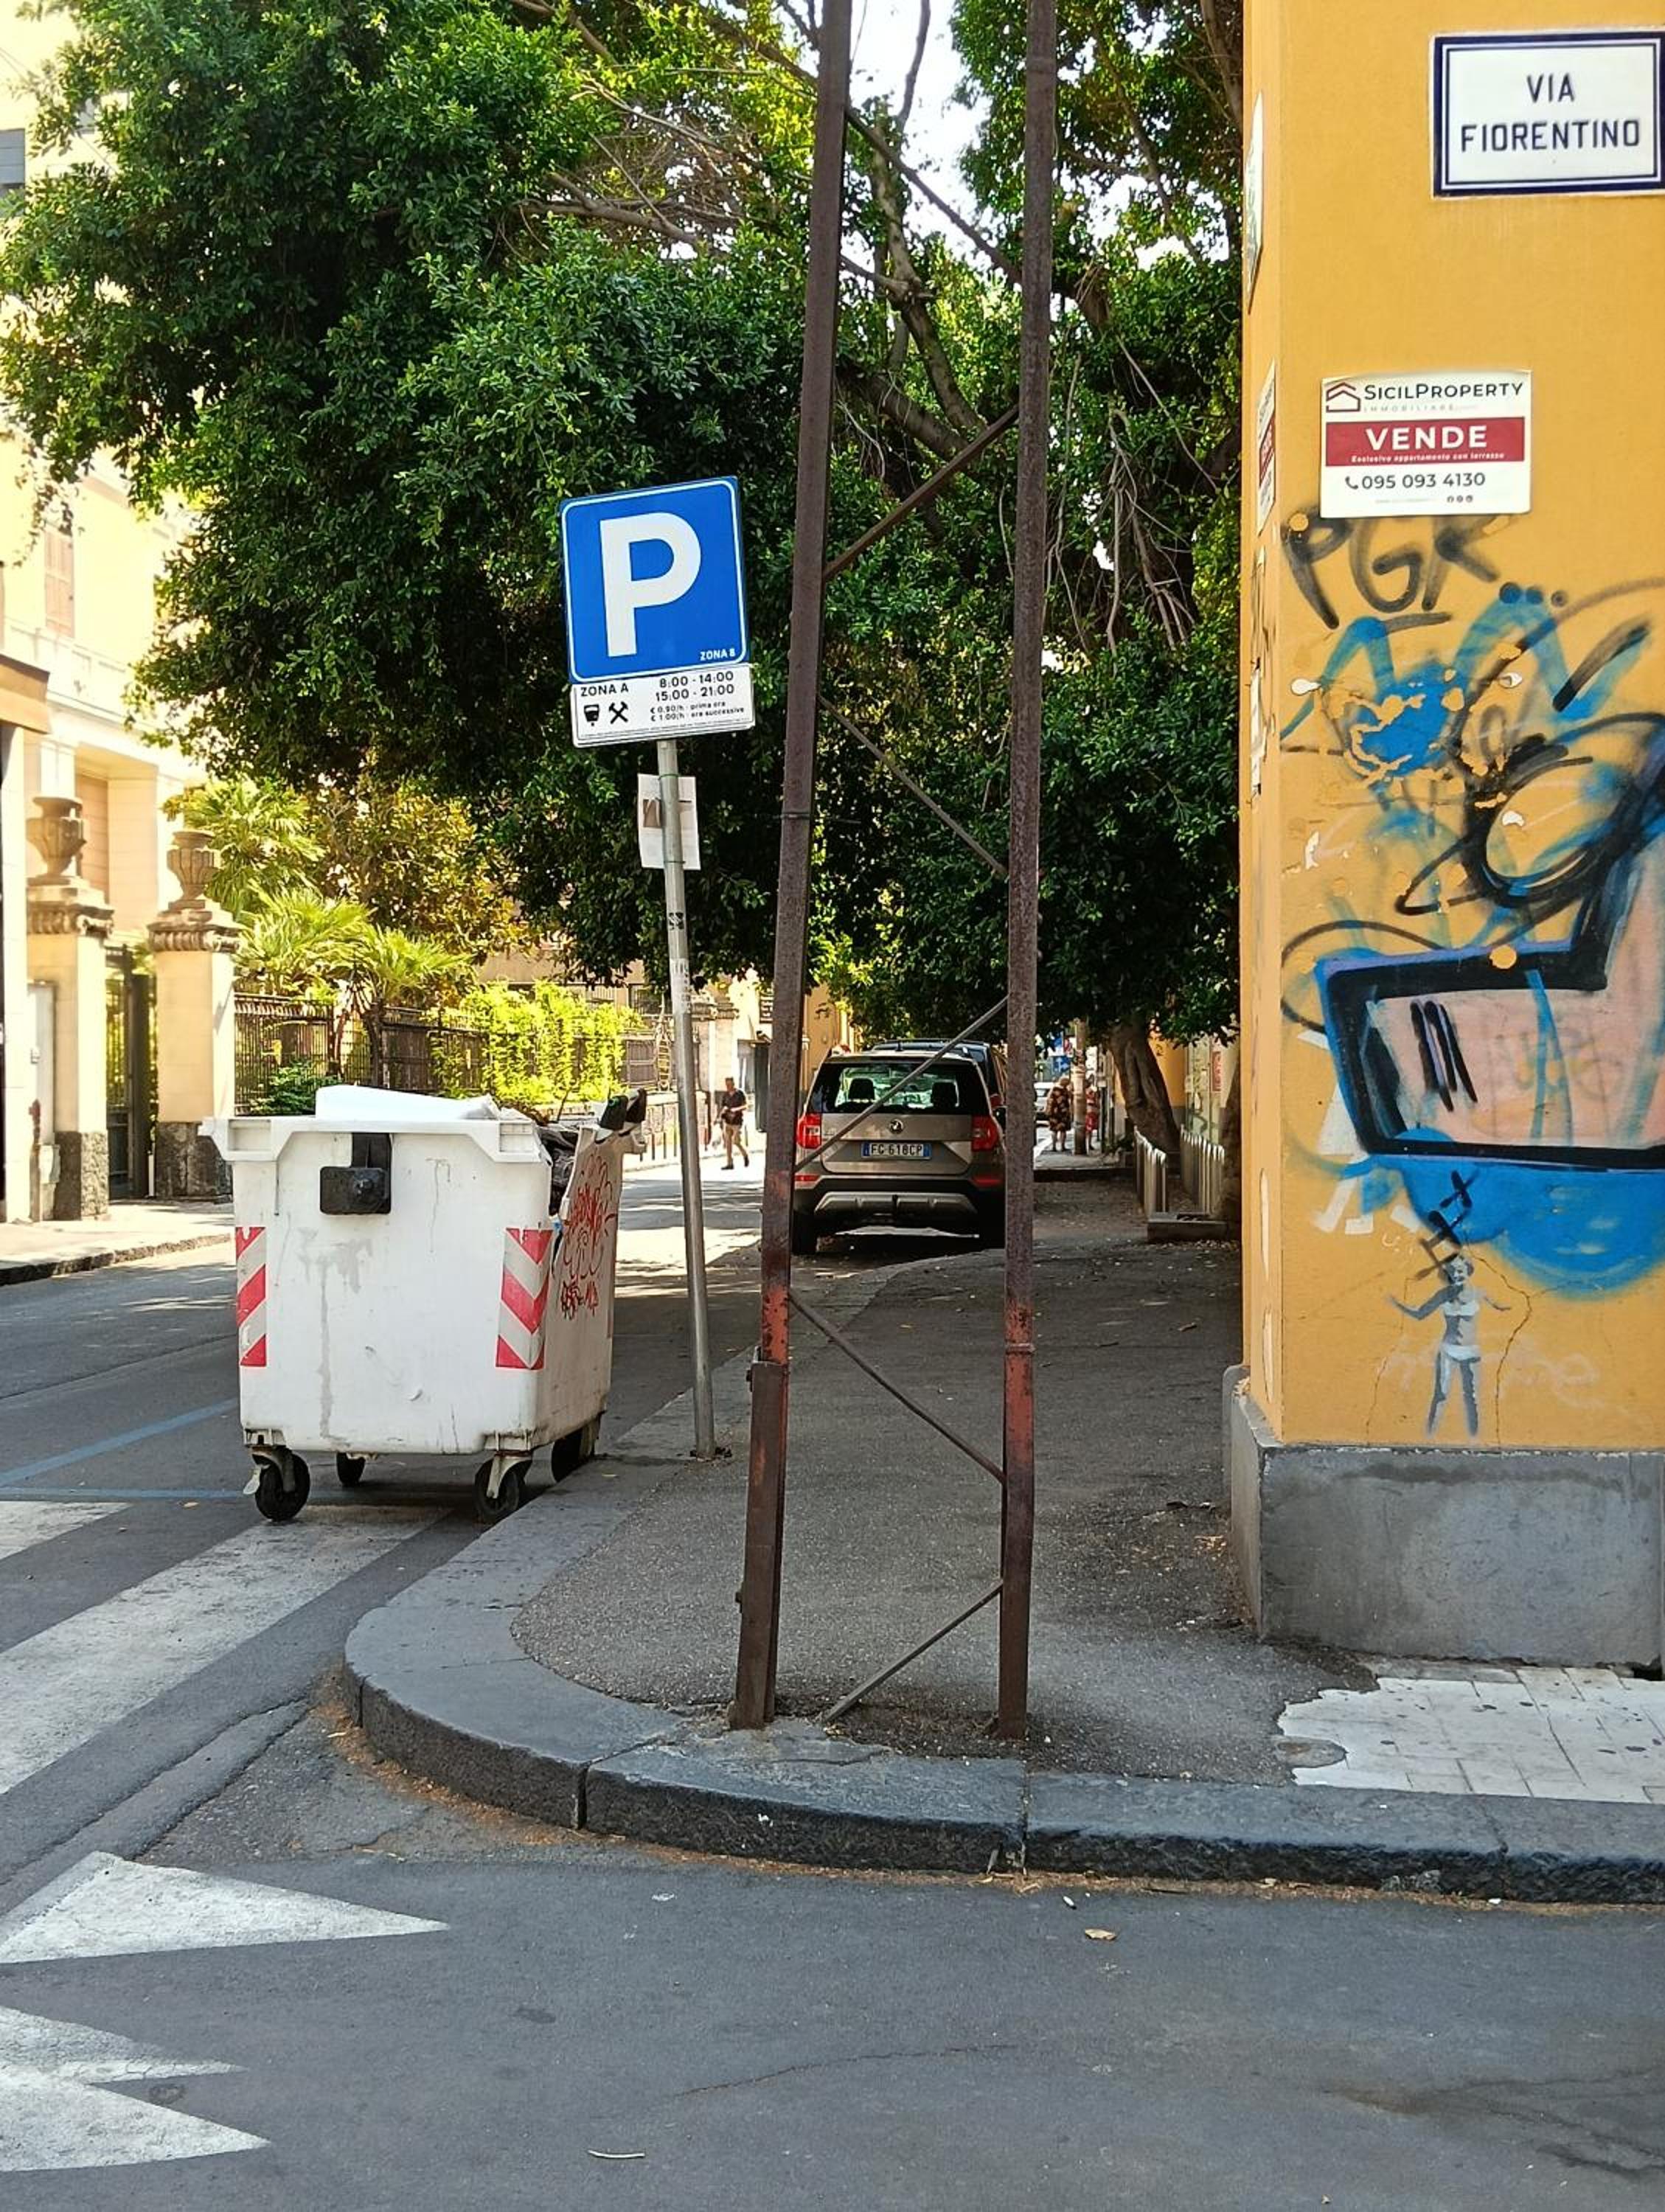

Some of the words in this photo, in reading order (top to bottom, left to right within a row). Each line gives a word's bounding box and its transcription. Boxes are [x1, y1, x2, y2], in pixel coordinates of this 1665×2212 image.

[1526, 73, 1574, 102] VIA
[1461, 119, 1639, 152] FIORENTINO
[1366, 425, 1487, 451] VENDE
[1362, 476, 1395, 489] 095
[1402, 474, 1436, 487] 093
[1443, 473, 1485, 487] 4130
[599, 512, 701, 657] P
[700, 650, 728, 661] ZONA
[659, 677, 688, 688] 8:00
[699, 671, 734, 684] 14:00
[580, 684, 617, 697] ZONA
[620, 682, 629, 693] A
[656, 689, 689, 702] 15:00
[701, 684, 735, 697] 21:00
